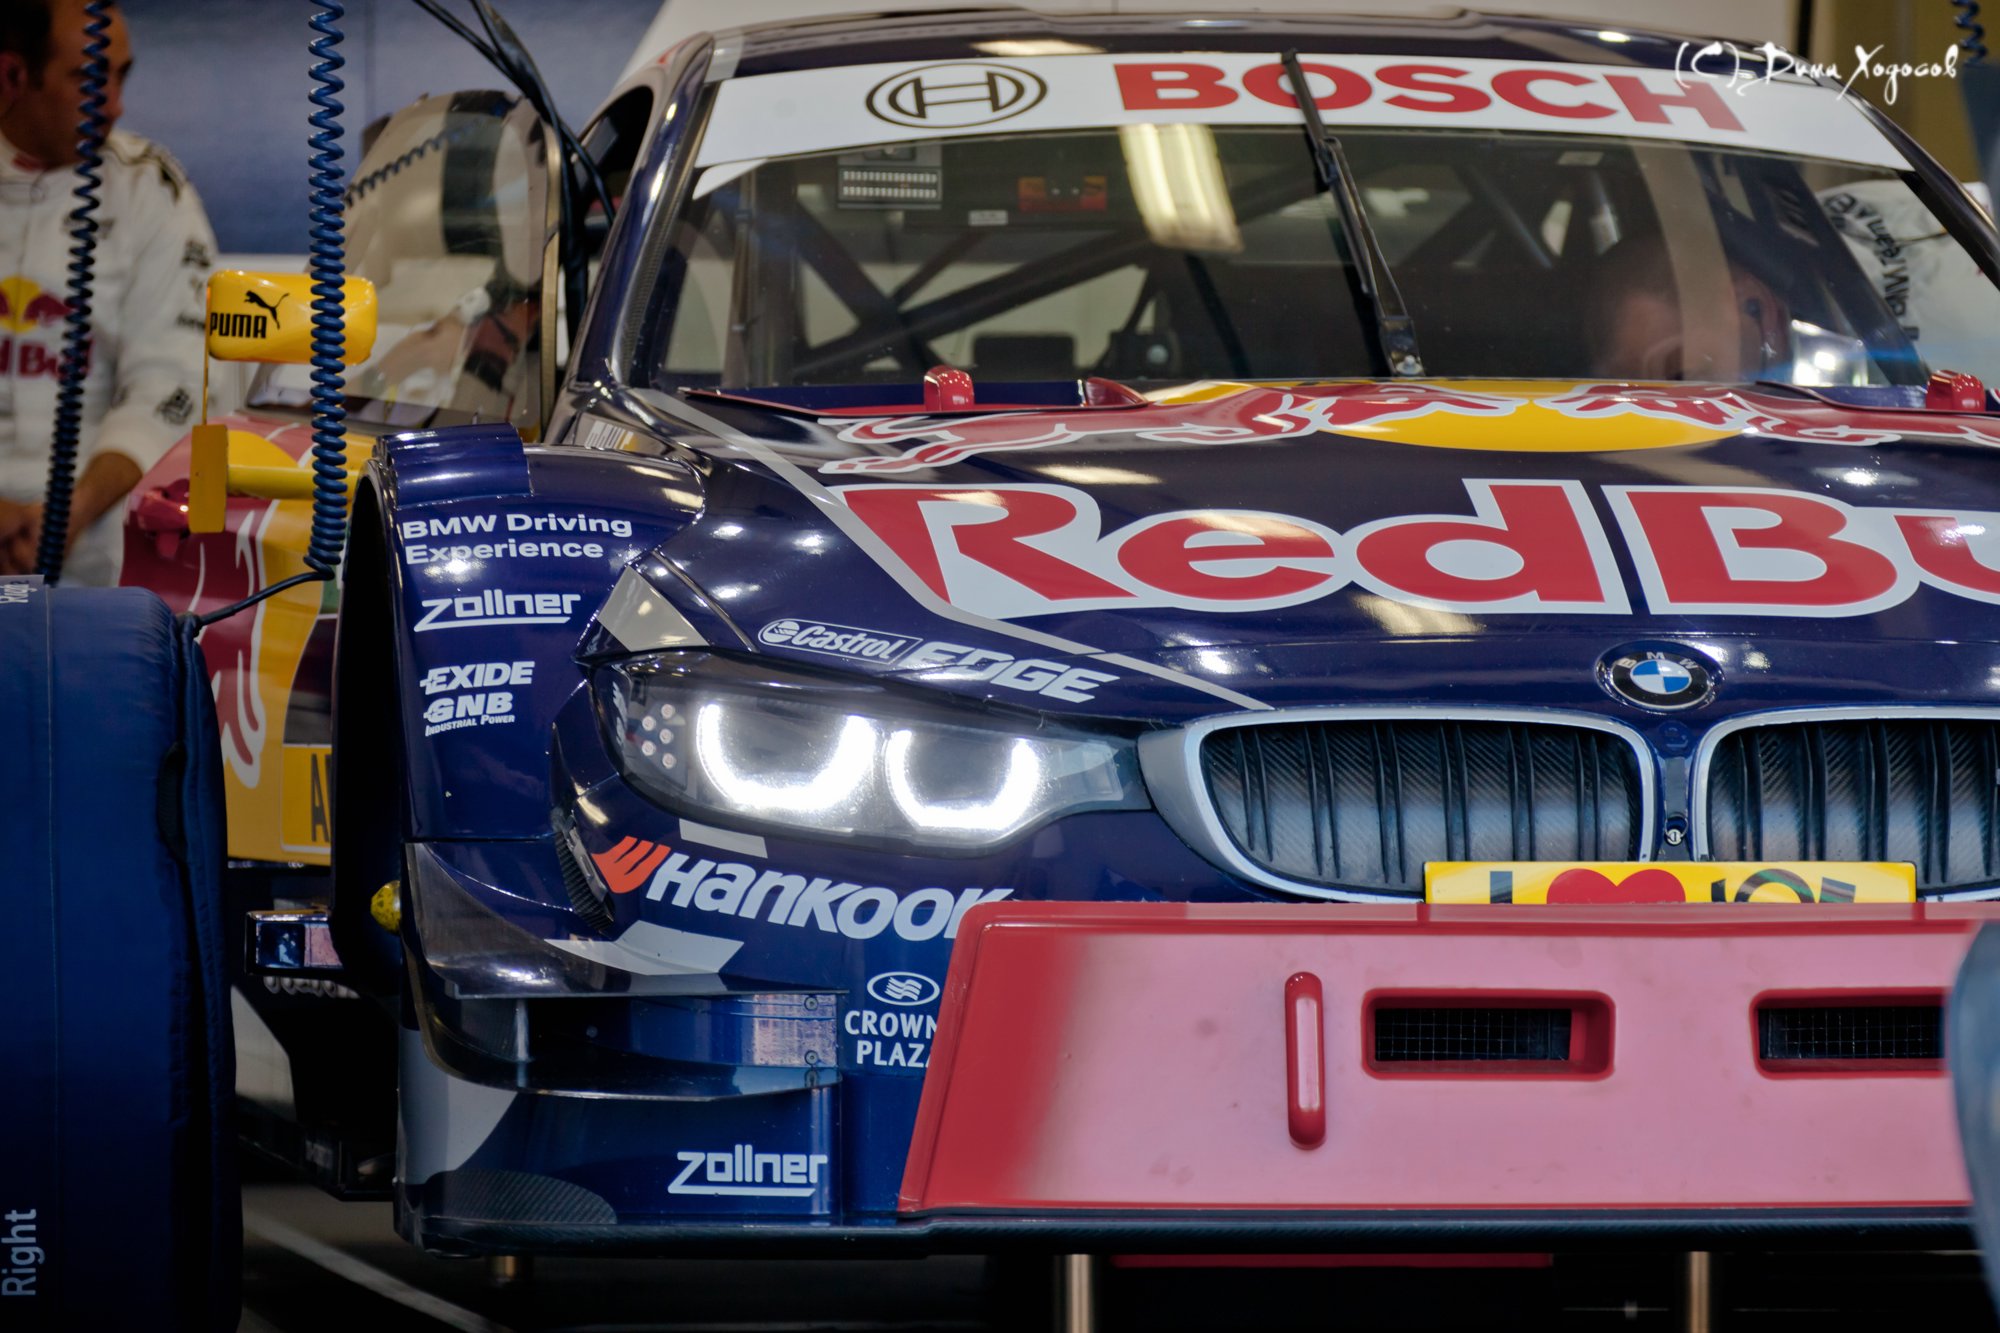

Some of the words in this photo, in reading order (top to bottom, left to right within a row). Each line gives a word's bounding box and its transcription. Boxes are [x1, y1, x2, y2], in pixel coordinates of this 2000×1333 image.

[1113, 62, 1746, 132] BOSCH
[210, 312, 267, 339] PUMA
[402, 514, 497, 539] BMW
[507, 513, 633, 538] Driving
[404, 538, 604, 566] Experience
[836, 481, 1620, 611] Red
[791, 625, 906, 660] Castrol
[893, 641, 1121, 703] EDGE
[1616, 651, 1700, 671] BMW
[420, 660, 536, 695] EXIDE
[423, 691, 514, 724] GNB
[844, 1009, 937, 1040] CROWN
[856, 1039, 931, 1069] PLAZ
[1, 1208, 46, 1297] Right
